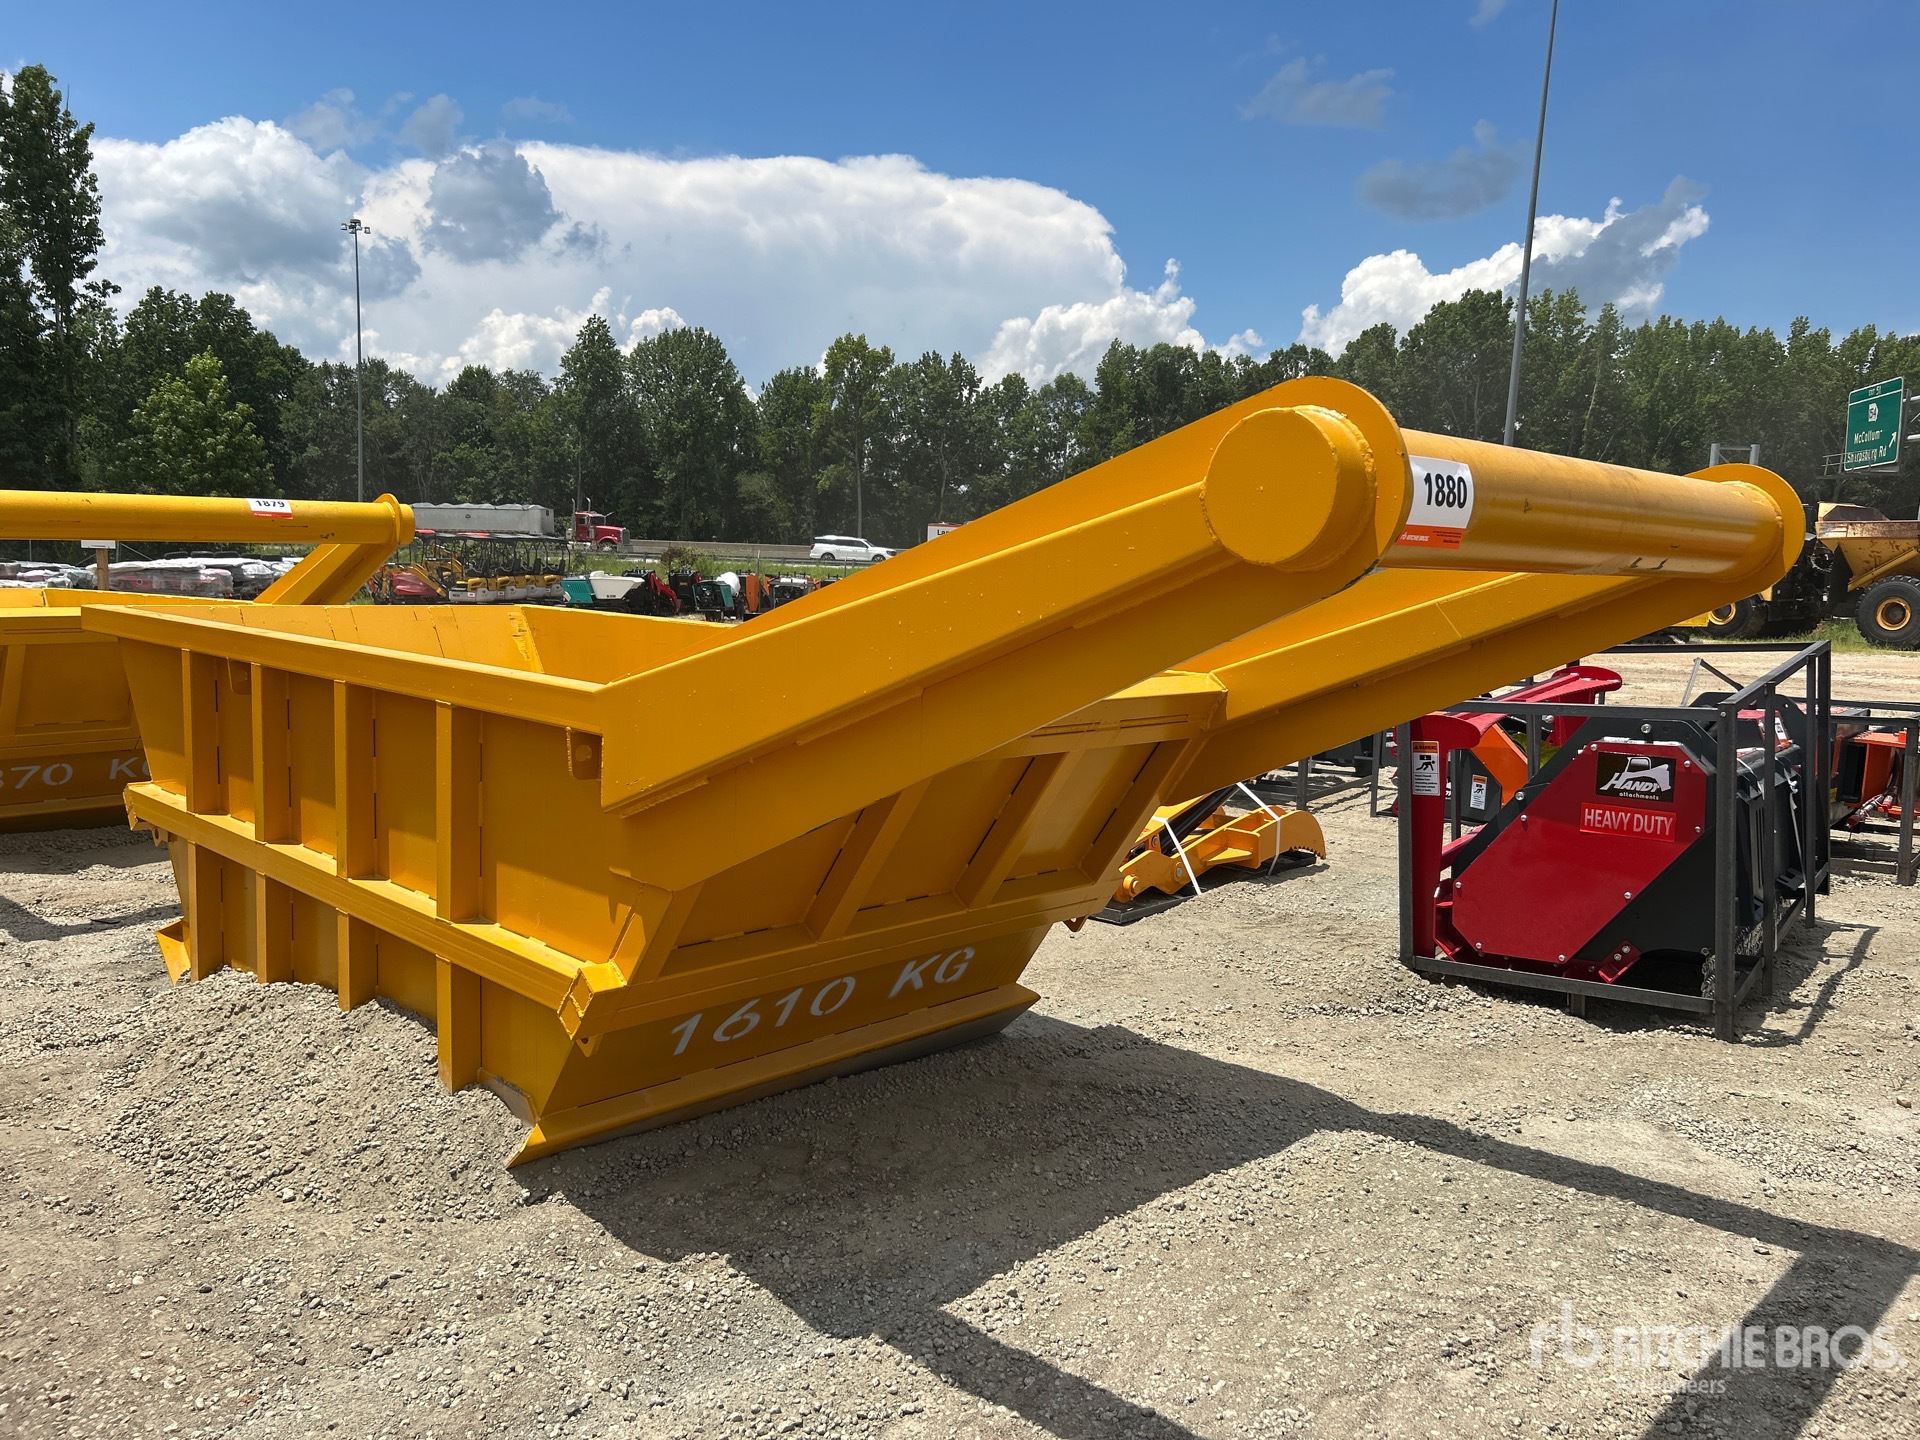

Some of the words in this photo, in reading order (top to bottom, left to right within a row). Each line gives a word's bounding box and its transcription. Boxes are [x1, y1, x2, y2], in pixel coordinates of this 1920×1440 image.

[1878, 446, 1887, 457] Rd
[255, 500, 285, 508] 1879
[1423, 472, 1468, 509] 1880
[0, 762, 74, 790] 70
[1618, 792, 1660, 801] attachments
[1584, 808, 1631, 831] HEAVY
[1633, 813, 1674, 836] DUTY
[671, 976, 857, 1056] 1610
[888, 946, 976, 1000] KG
